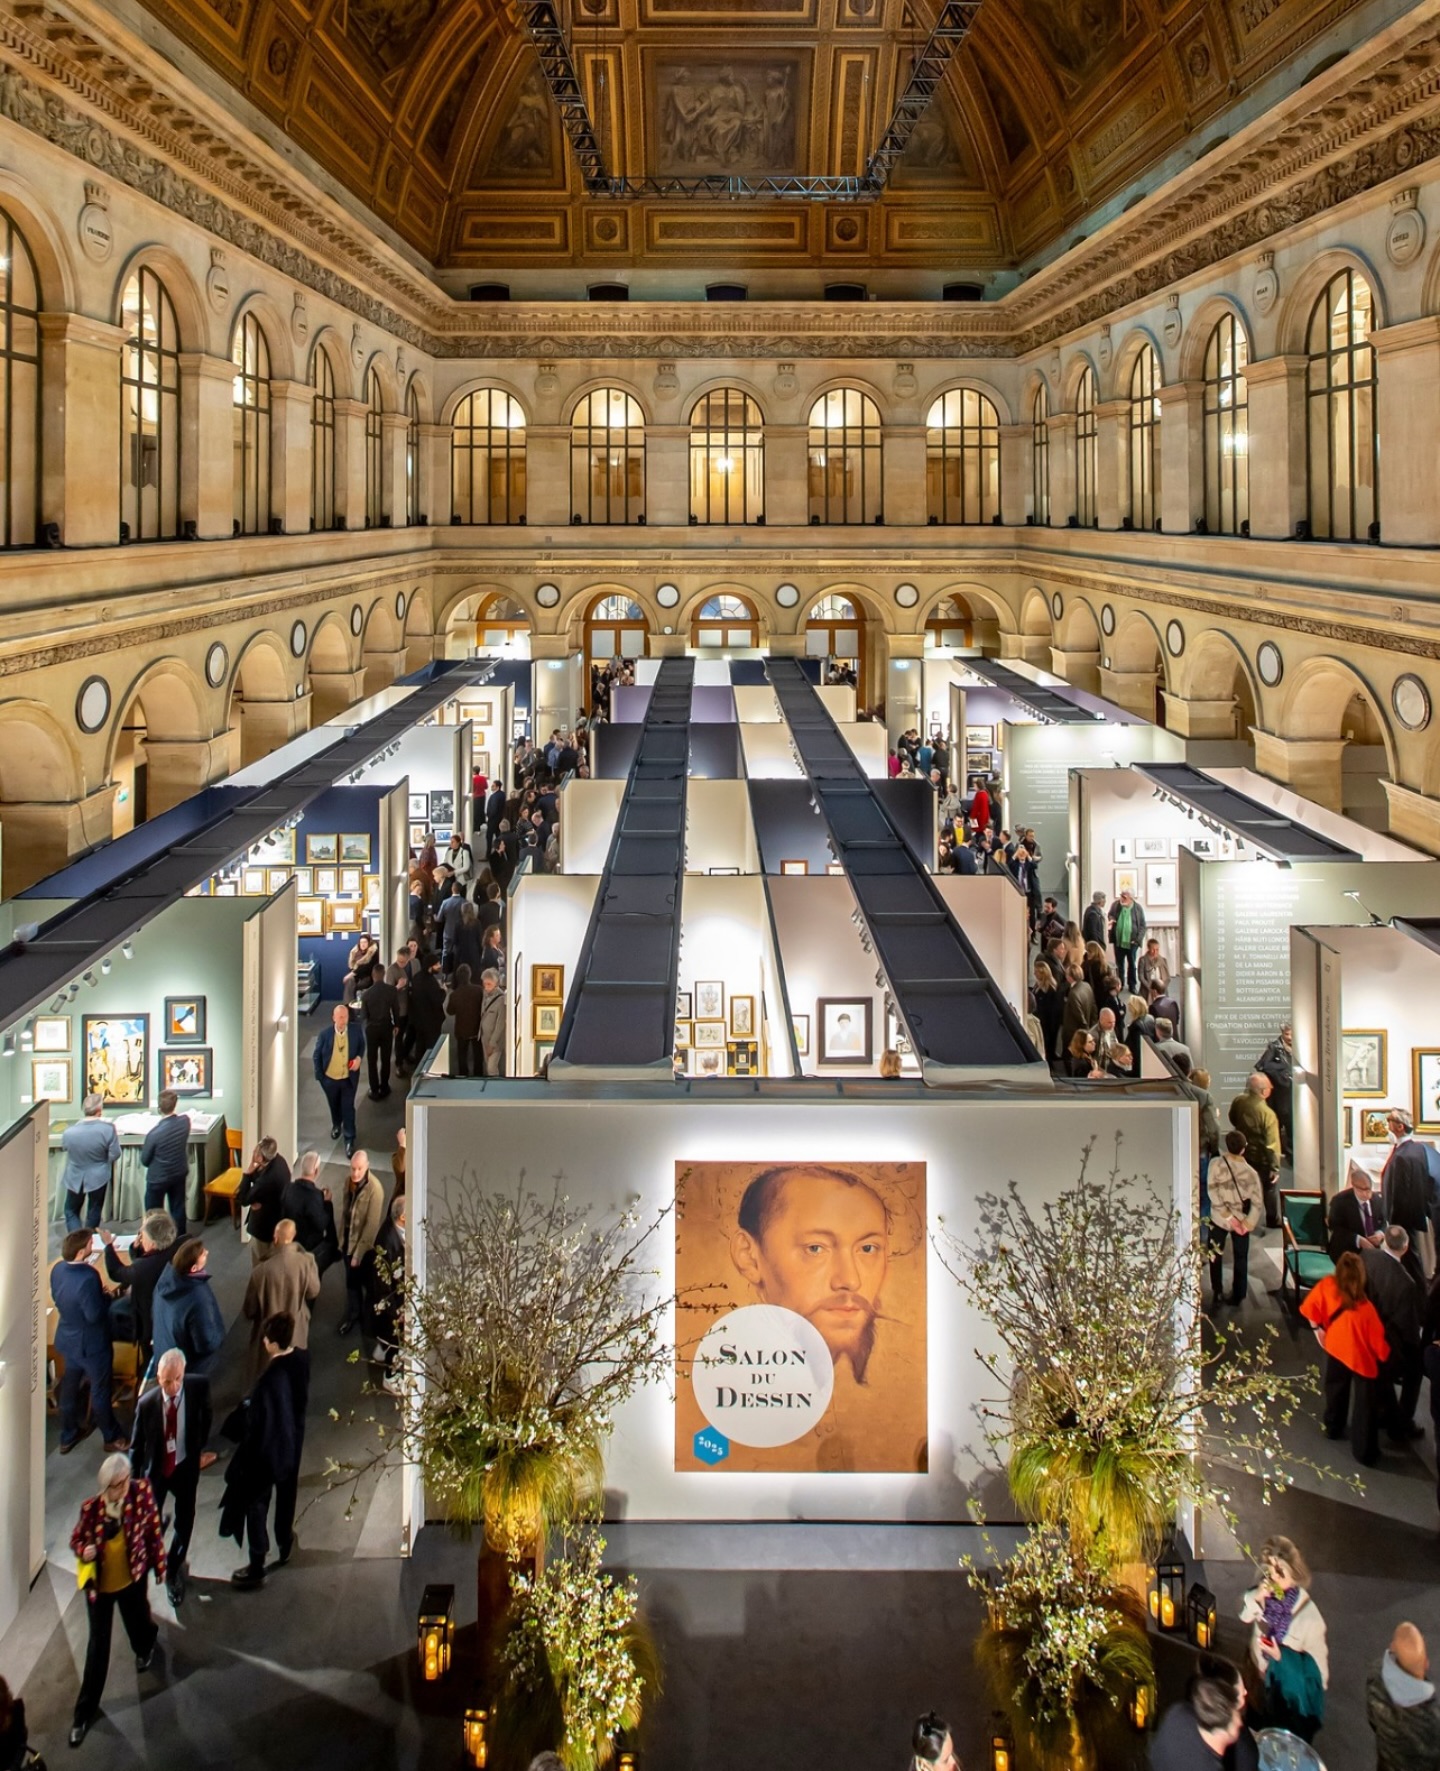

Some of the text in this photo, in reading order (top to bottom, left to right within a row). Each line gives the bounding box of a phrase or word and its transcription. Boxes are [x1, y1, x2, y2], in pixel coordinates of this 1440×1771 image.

[30, 1299, 40, 1344] Ronny
[718, 1344, 806, 1365] SALON
[30, 1346, 38, 1394] Galerie
[751, 1373, 776, 1385] DU
[716, 1387, 812, 1408] DESSIN
[698, 1436, 724, 1456] 2025
